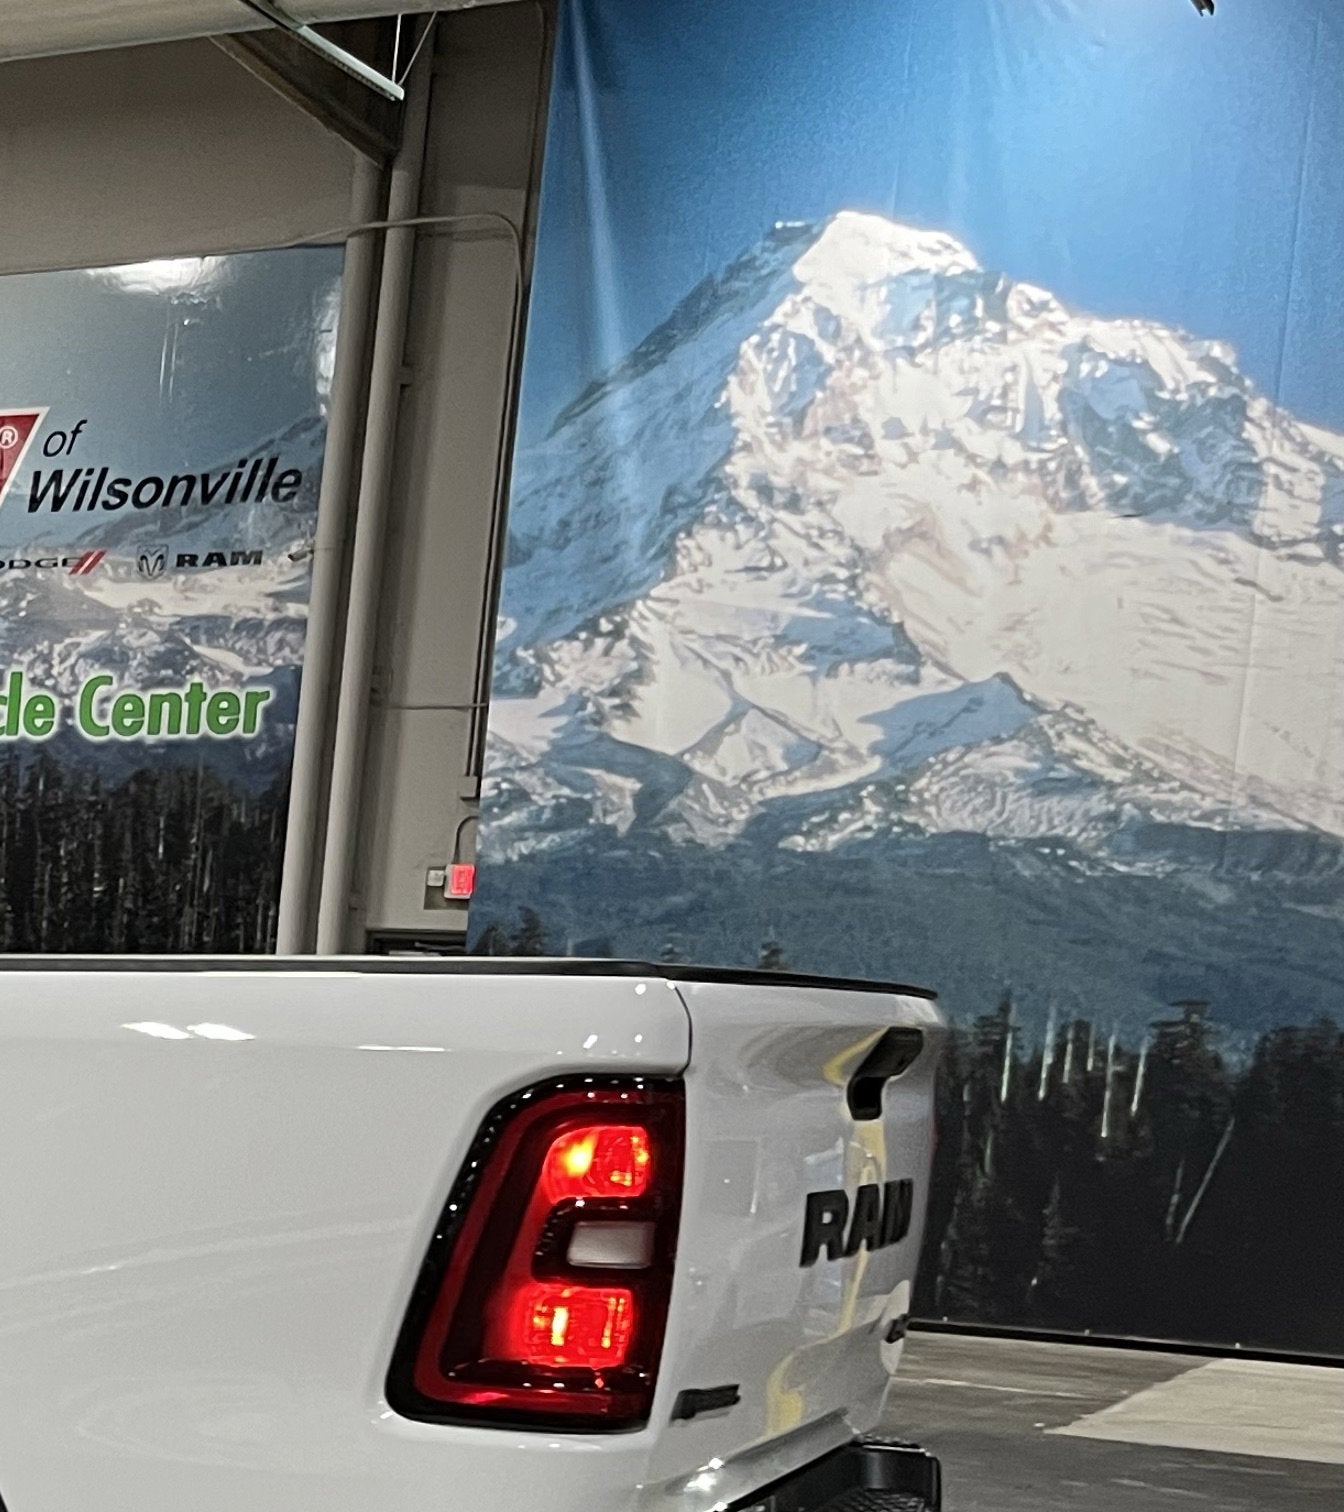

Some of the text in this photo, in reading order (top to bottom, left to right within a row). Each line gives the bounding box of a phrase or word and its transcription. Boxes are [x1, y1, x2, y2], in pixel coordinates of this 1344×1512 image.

[42, 419, 88, 458] of
[25, 457, 303, 515] Wilsonville
[175, 550, 264, 569] RAM
[79, 675, 271, 737] Center
[798, 1177, 914, 1269] RAM
